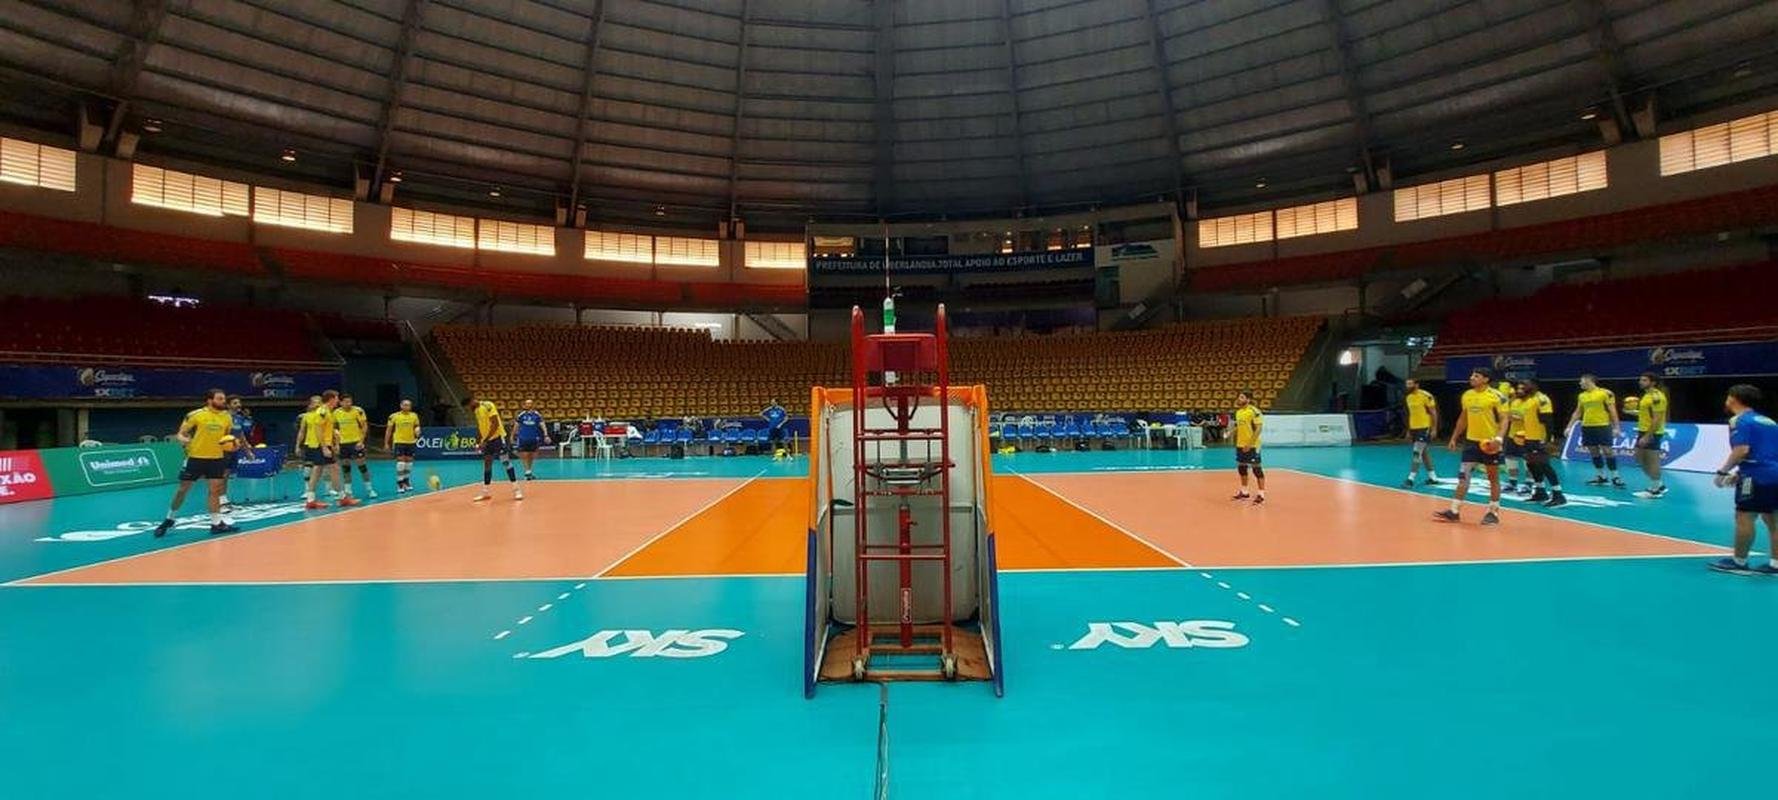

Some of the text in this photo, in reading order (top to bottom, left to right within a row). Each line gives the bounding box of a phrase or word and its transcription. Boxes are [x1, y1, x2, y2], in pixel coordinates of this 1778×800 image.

[90, 458, 135, 471] Unimed
[527, 629, 745, 659] SKY
[1068, 620, 1250, 650] SKY
